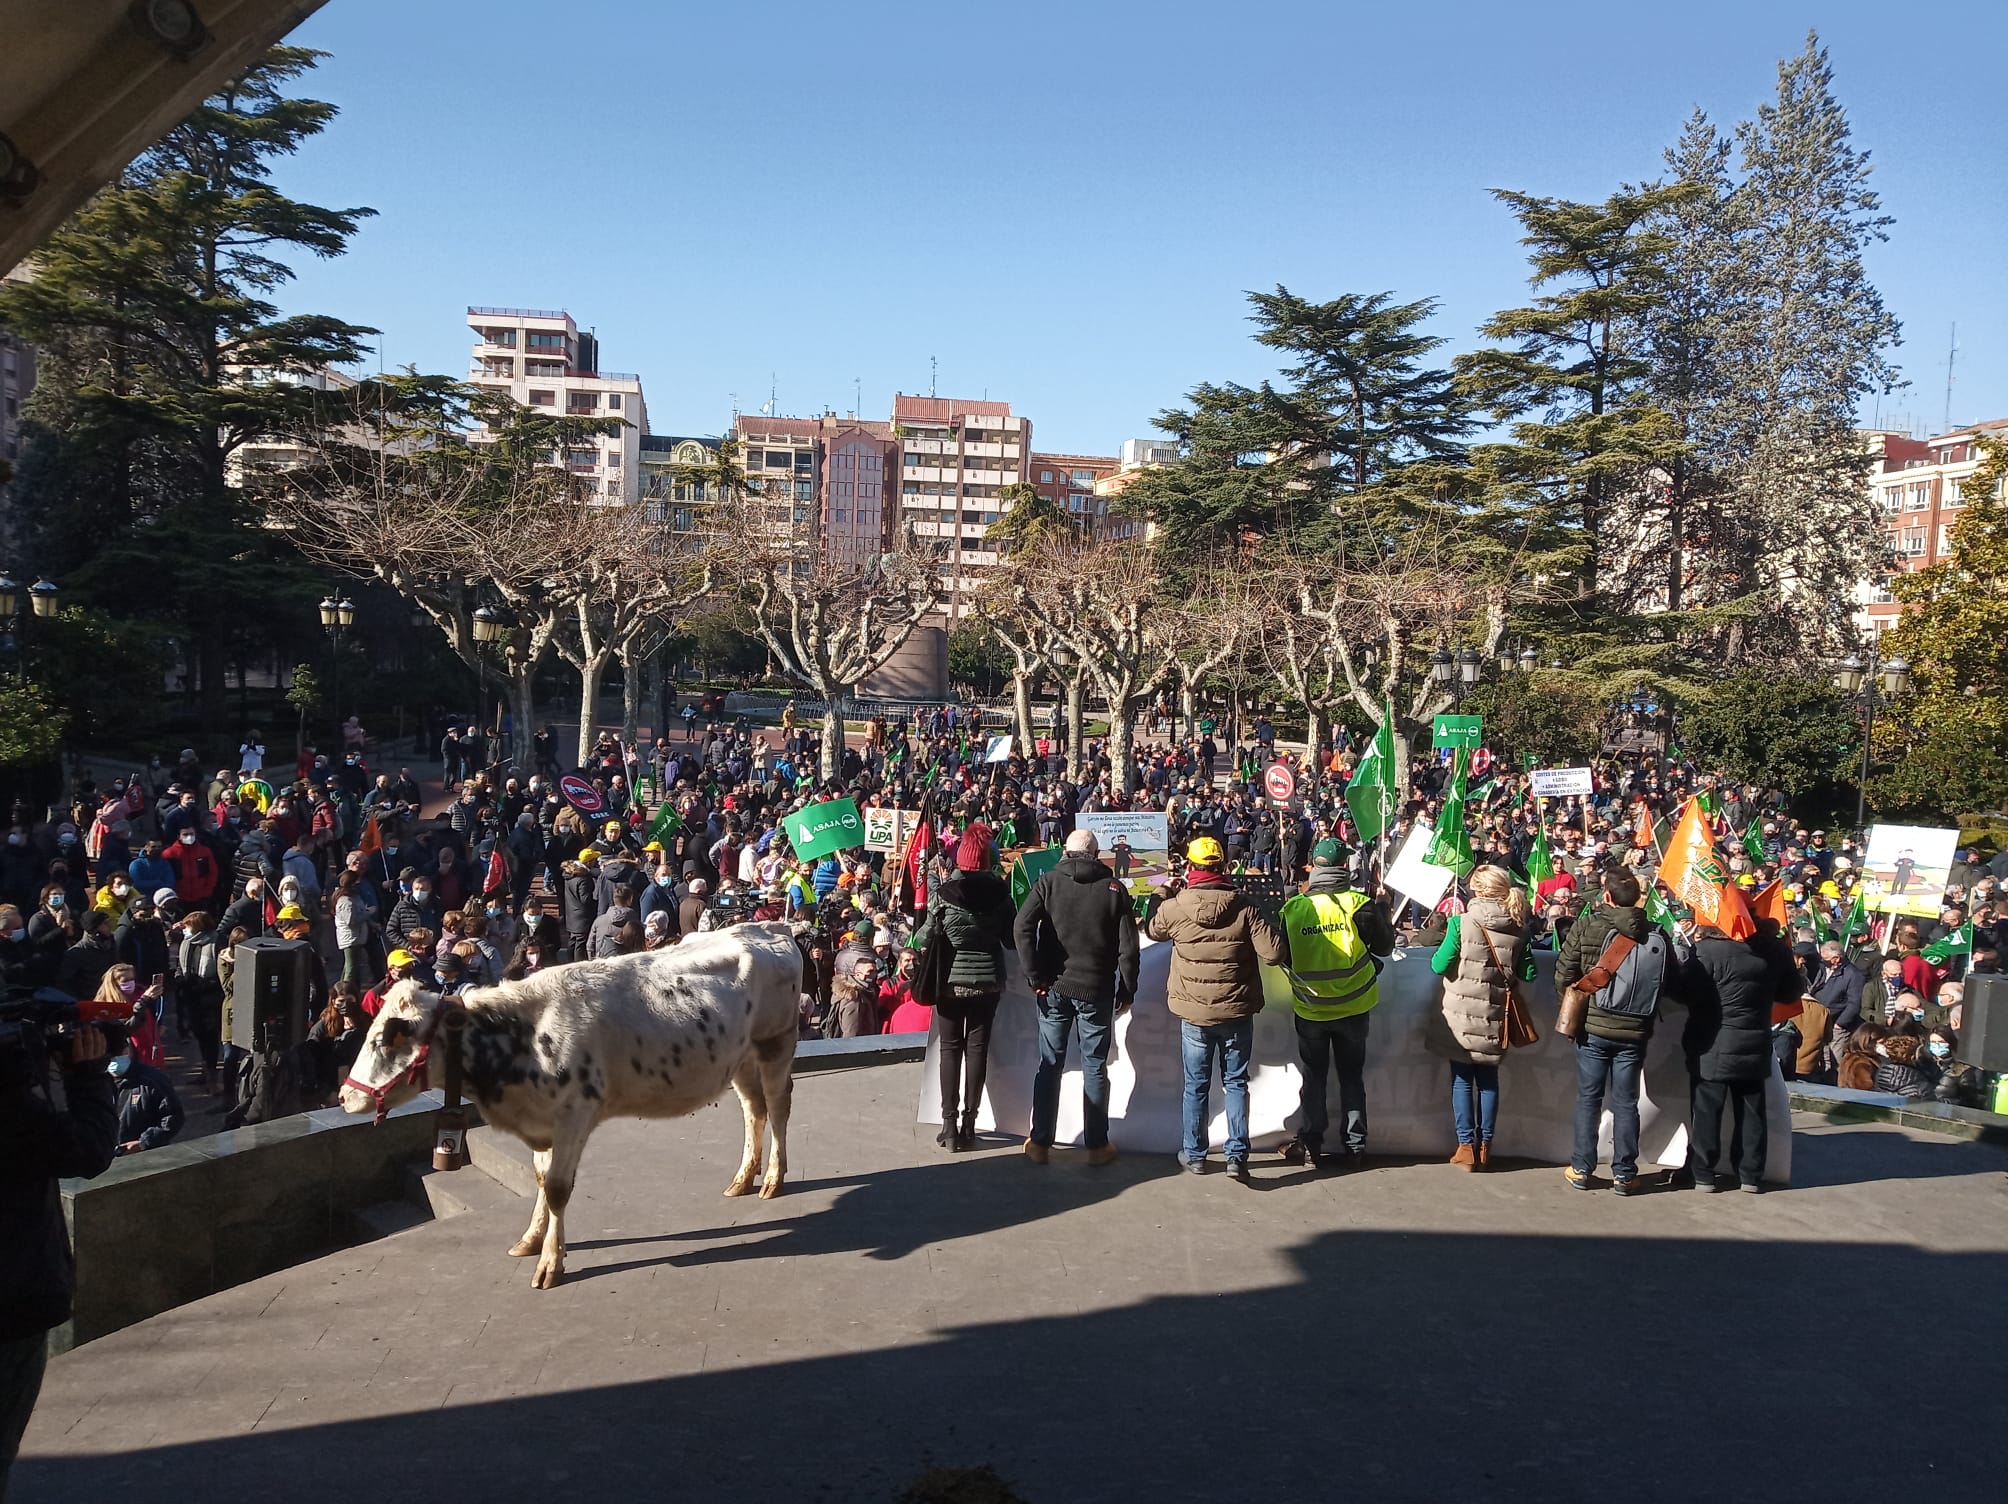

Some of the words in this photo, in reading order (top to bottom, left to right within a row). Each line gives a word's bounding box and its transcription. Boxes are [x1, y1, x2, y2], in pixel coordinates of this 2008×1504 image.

[813, 819, 841, 832] ASAJA
[870, 830, 893, 842] UPA
[1301, 922, 1345, 936] ORGANIZAC
